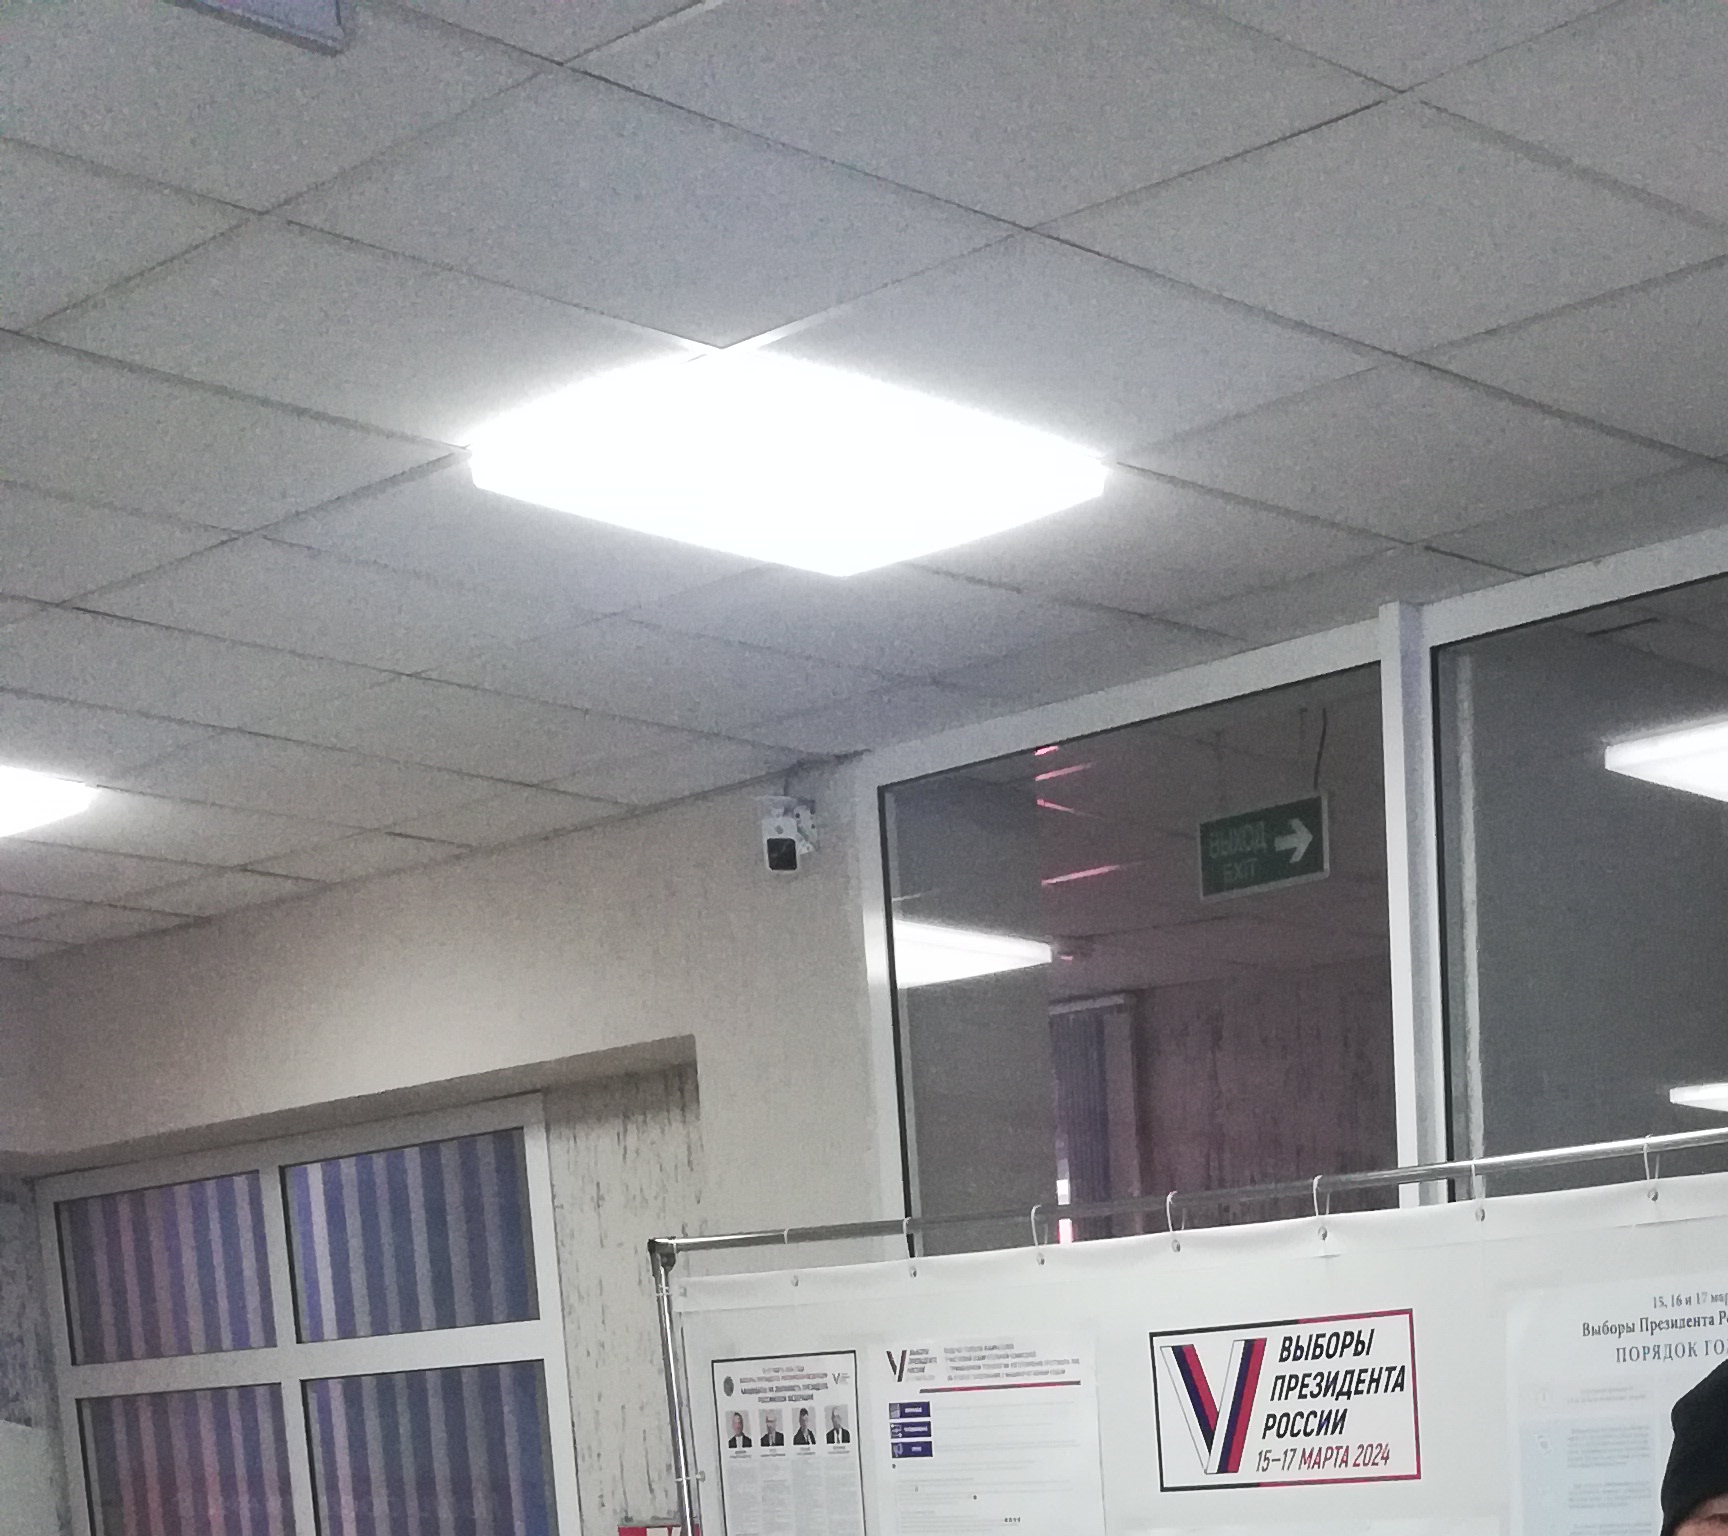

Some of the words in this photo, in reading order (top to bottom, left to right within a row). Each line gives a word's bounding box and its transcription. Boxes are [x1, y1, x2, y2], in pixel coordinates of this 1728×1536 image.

[1671, 1294, 1683, 1308] 16
[1685, 1296, 1692, 1306] и
[1582, 1320, 1636, 1339] Выборы
[1639, 1315, 1715, 1336] Президента
[1278, 1328, 1375, 1363] ВЫБОРЫ
[1616, 1341, 1698, 1363] ПОРЯДОК
[1270, 1365, 1406, 1401] ПРЕЗИДЕНТА
[1262, 1408, 1348, 1439] РОССИИ
[1298, 1445, 1350, 1470] МАРТА
[1352, 1443, 1391, 1468] 2024
